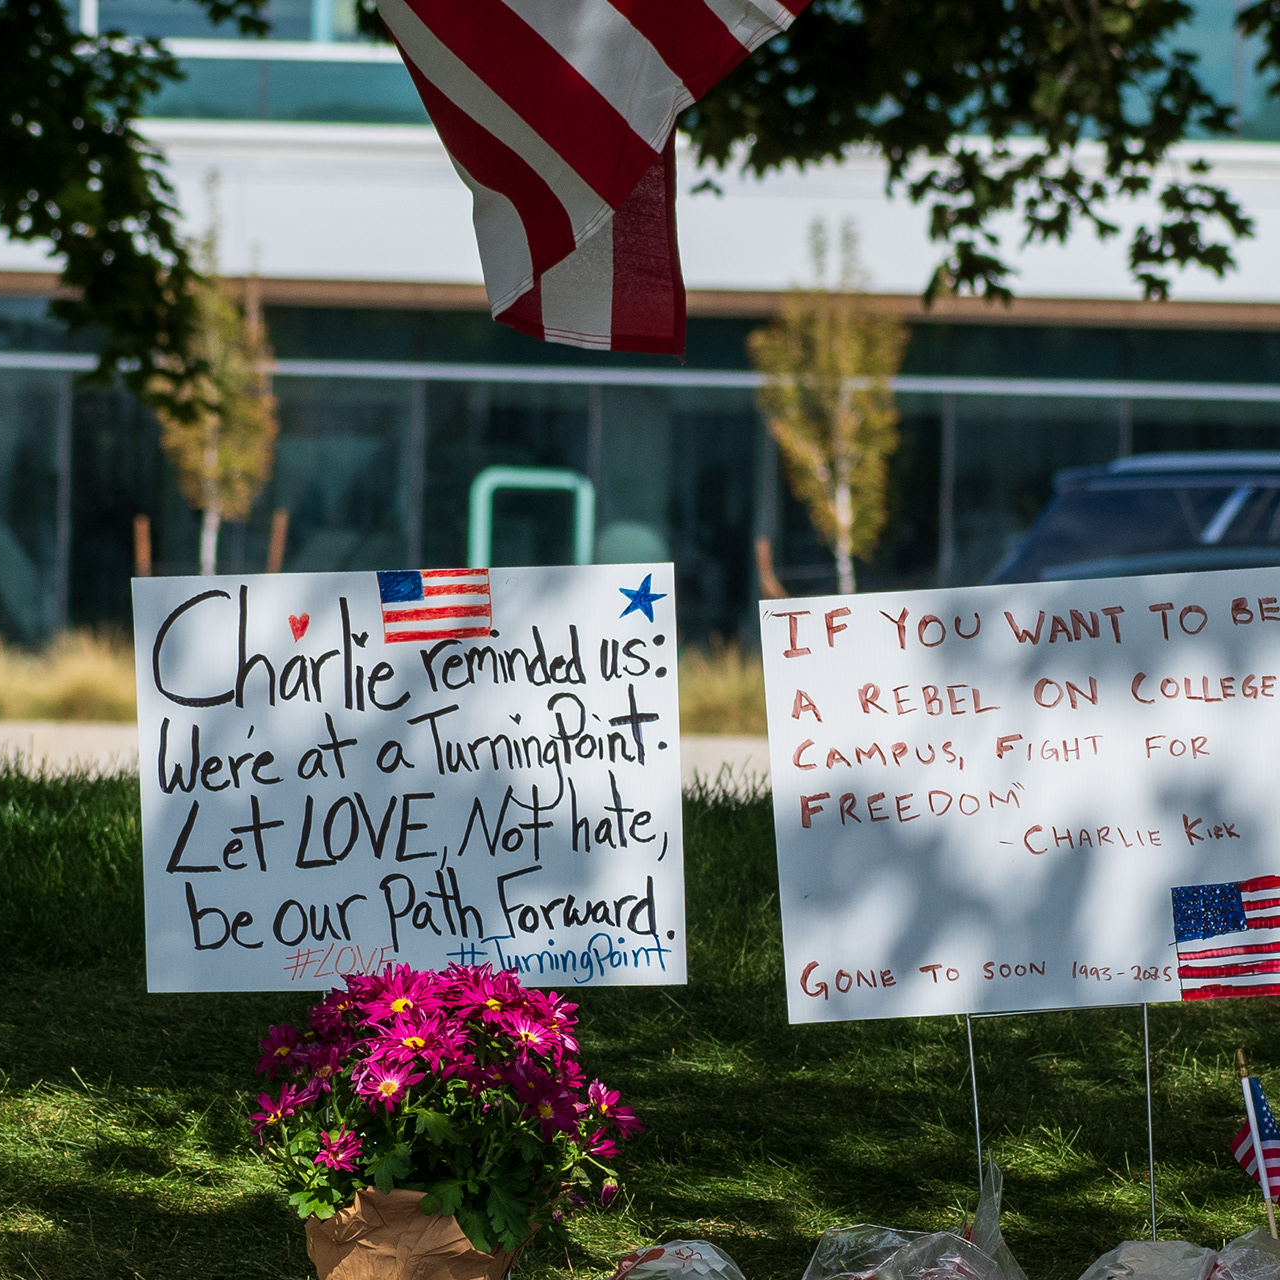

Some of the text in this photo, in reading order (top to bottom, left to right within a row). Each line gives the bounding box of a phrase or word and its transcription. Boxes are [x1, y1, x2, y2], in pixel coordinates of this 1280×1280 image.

[153, 585, 668, 711] Charlie reminded us:
[879, 608, 981, 650] YOU
[1004, 605, 1124, 645] WANT
[1149, 602, 1207, 642] TO
[1231, 596, 1280, 625] BE
[791, 672, 1278, 724] A REBEL ON COLLEGE
[160, 717, 284, 795] We're
[297, 712, 358, 782] at
[377, 747, 416, 774] a
[792, 733, 1212, 771] CAMPUS, FIGHT FOR
[166, 770, 670, 874] Let LOVE, Not hate,
[185, 865, 677, 954] be our Path Forward.
[285, 943, 398, 981] #LOVE
[800, 961, 898, 1001] GONE
[919, 962, 960, 984] TO
[983, 960, 1047, 981] SOON
